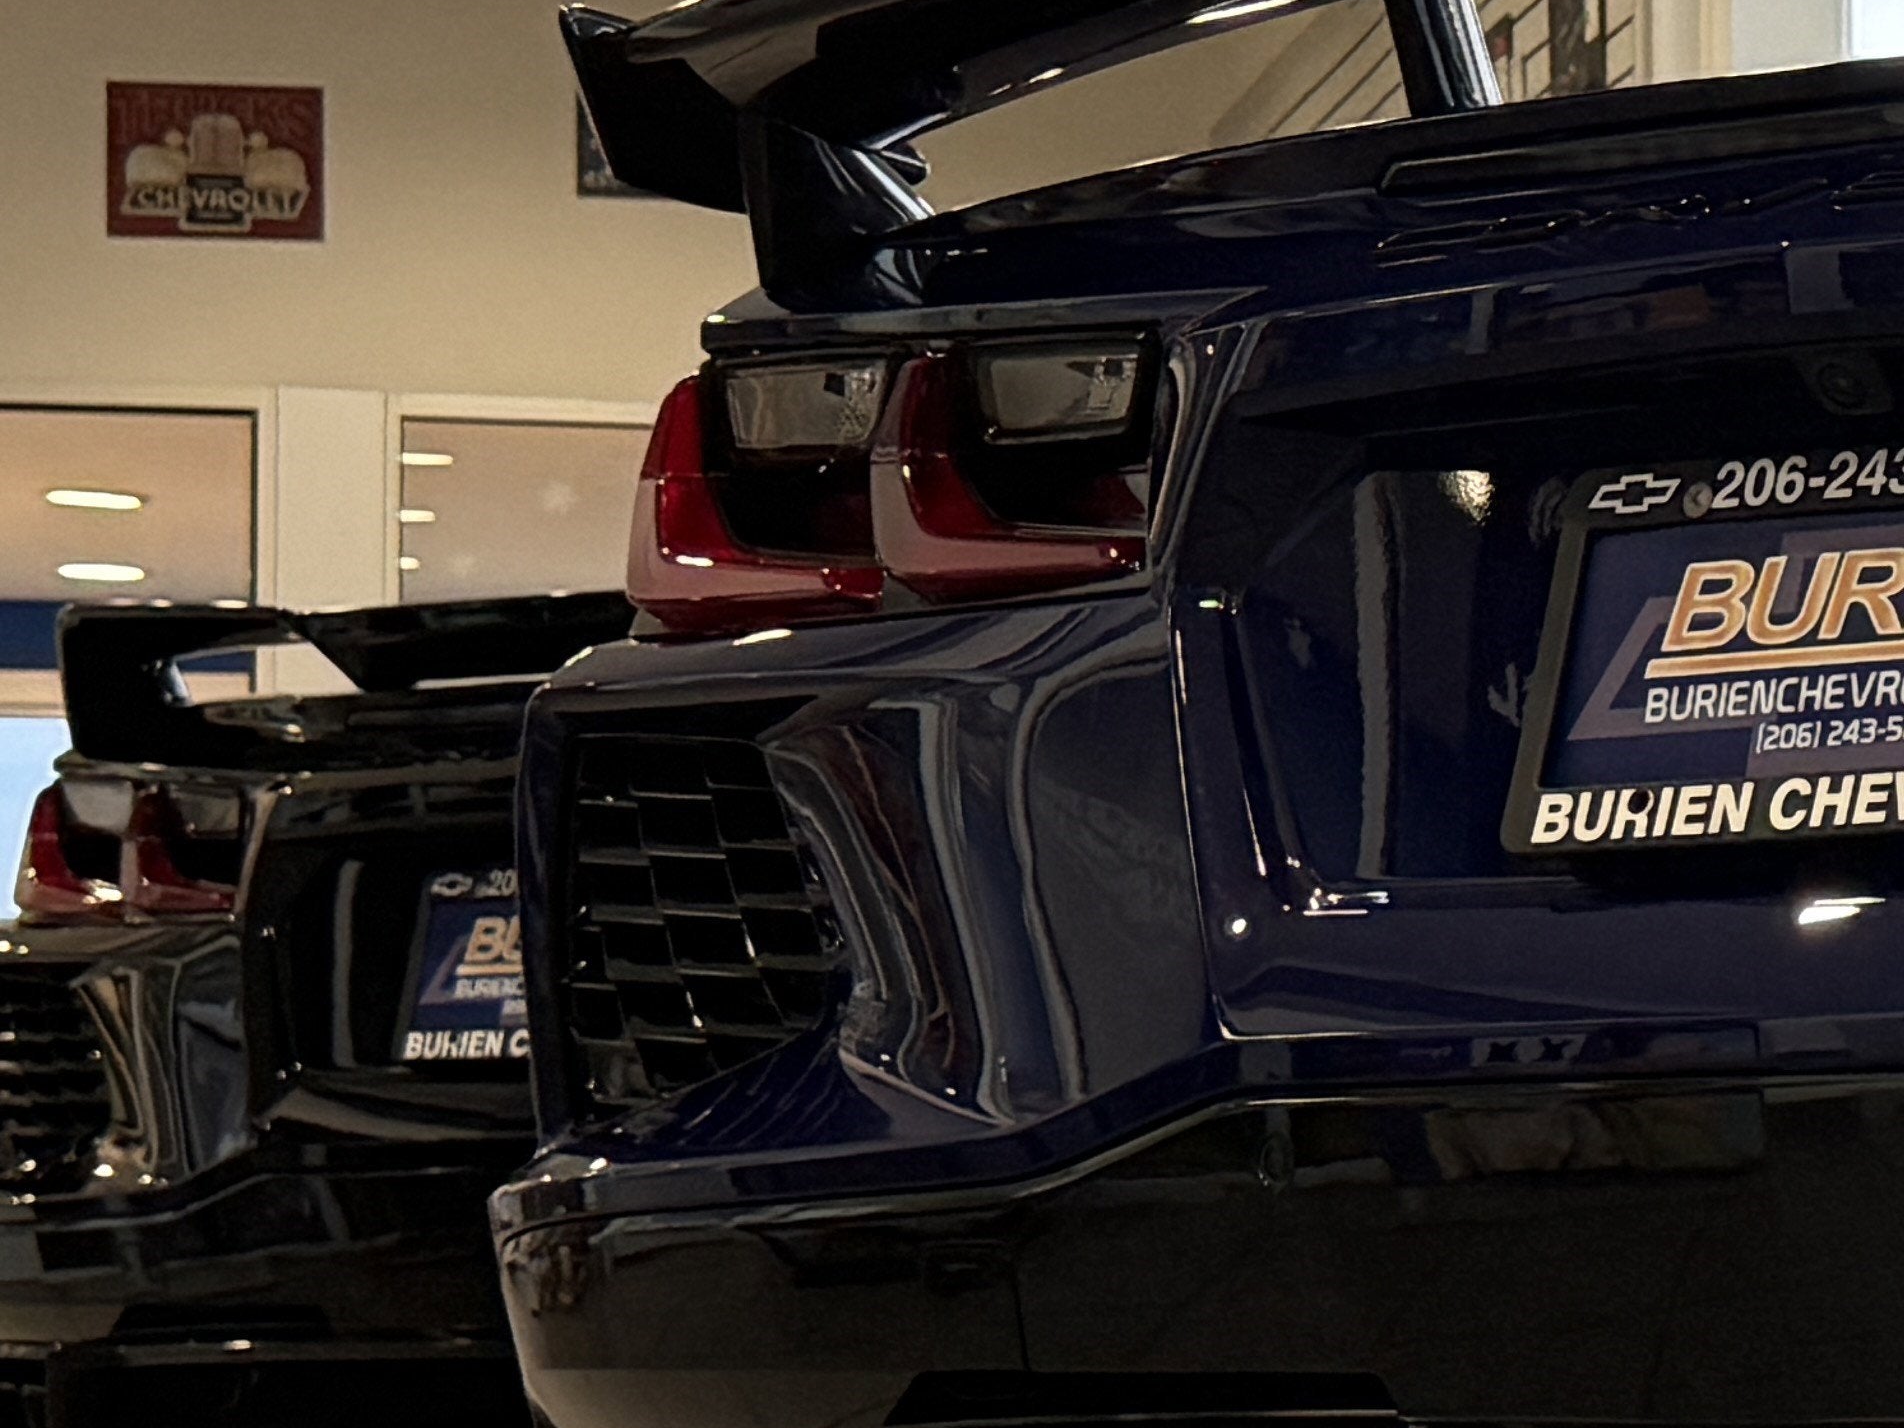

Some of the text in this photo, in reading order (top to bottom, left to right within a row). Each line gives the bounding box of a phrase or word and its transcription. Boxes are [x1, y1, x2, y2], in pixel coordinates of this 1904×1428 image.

[136, 184, 301, 217] CHEVROLET
[1755, 721, 1821, 755] (206)
[1530, 781, 1755, 844] BURIEN
